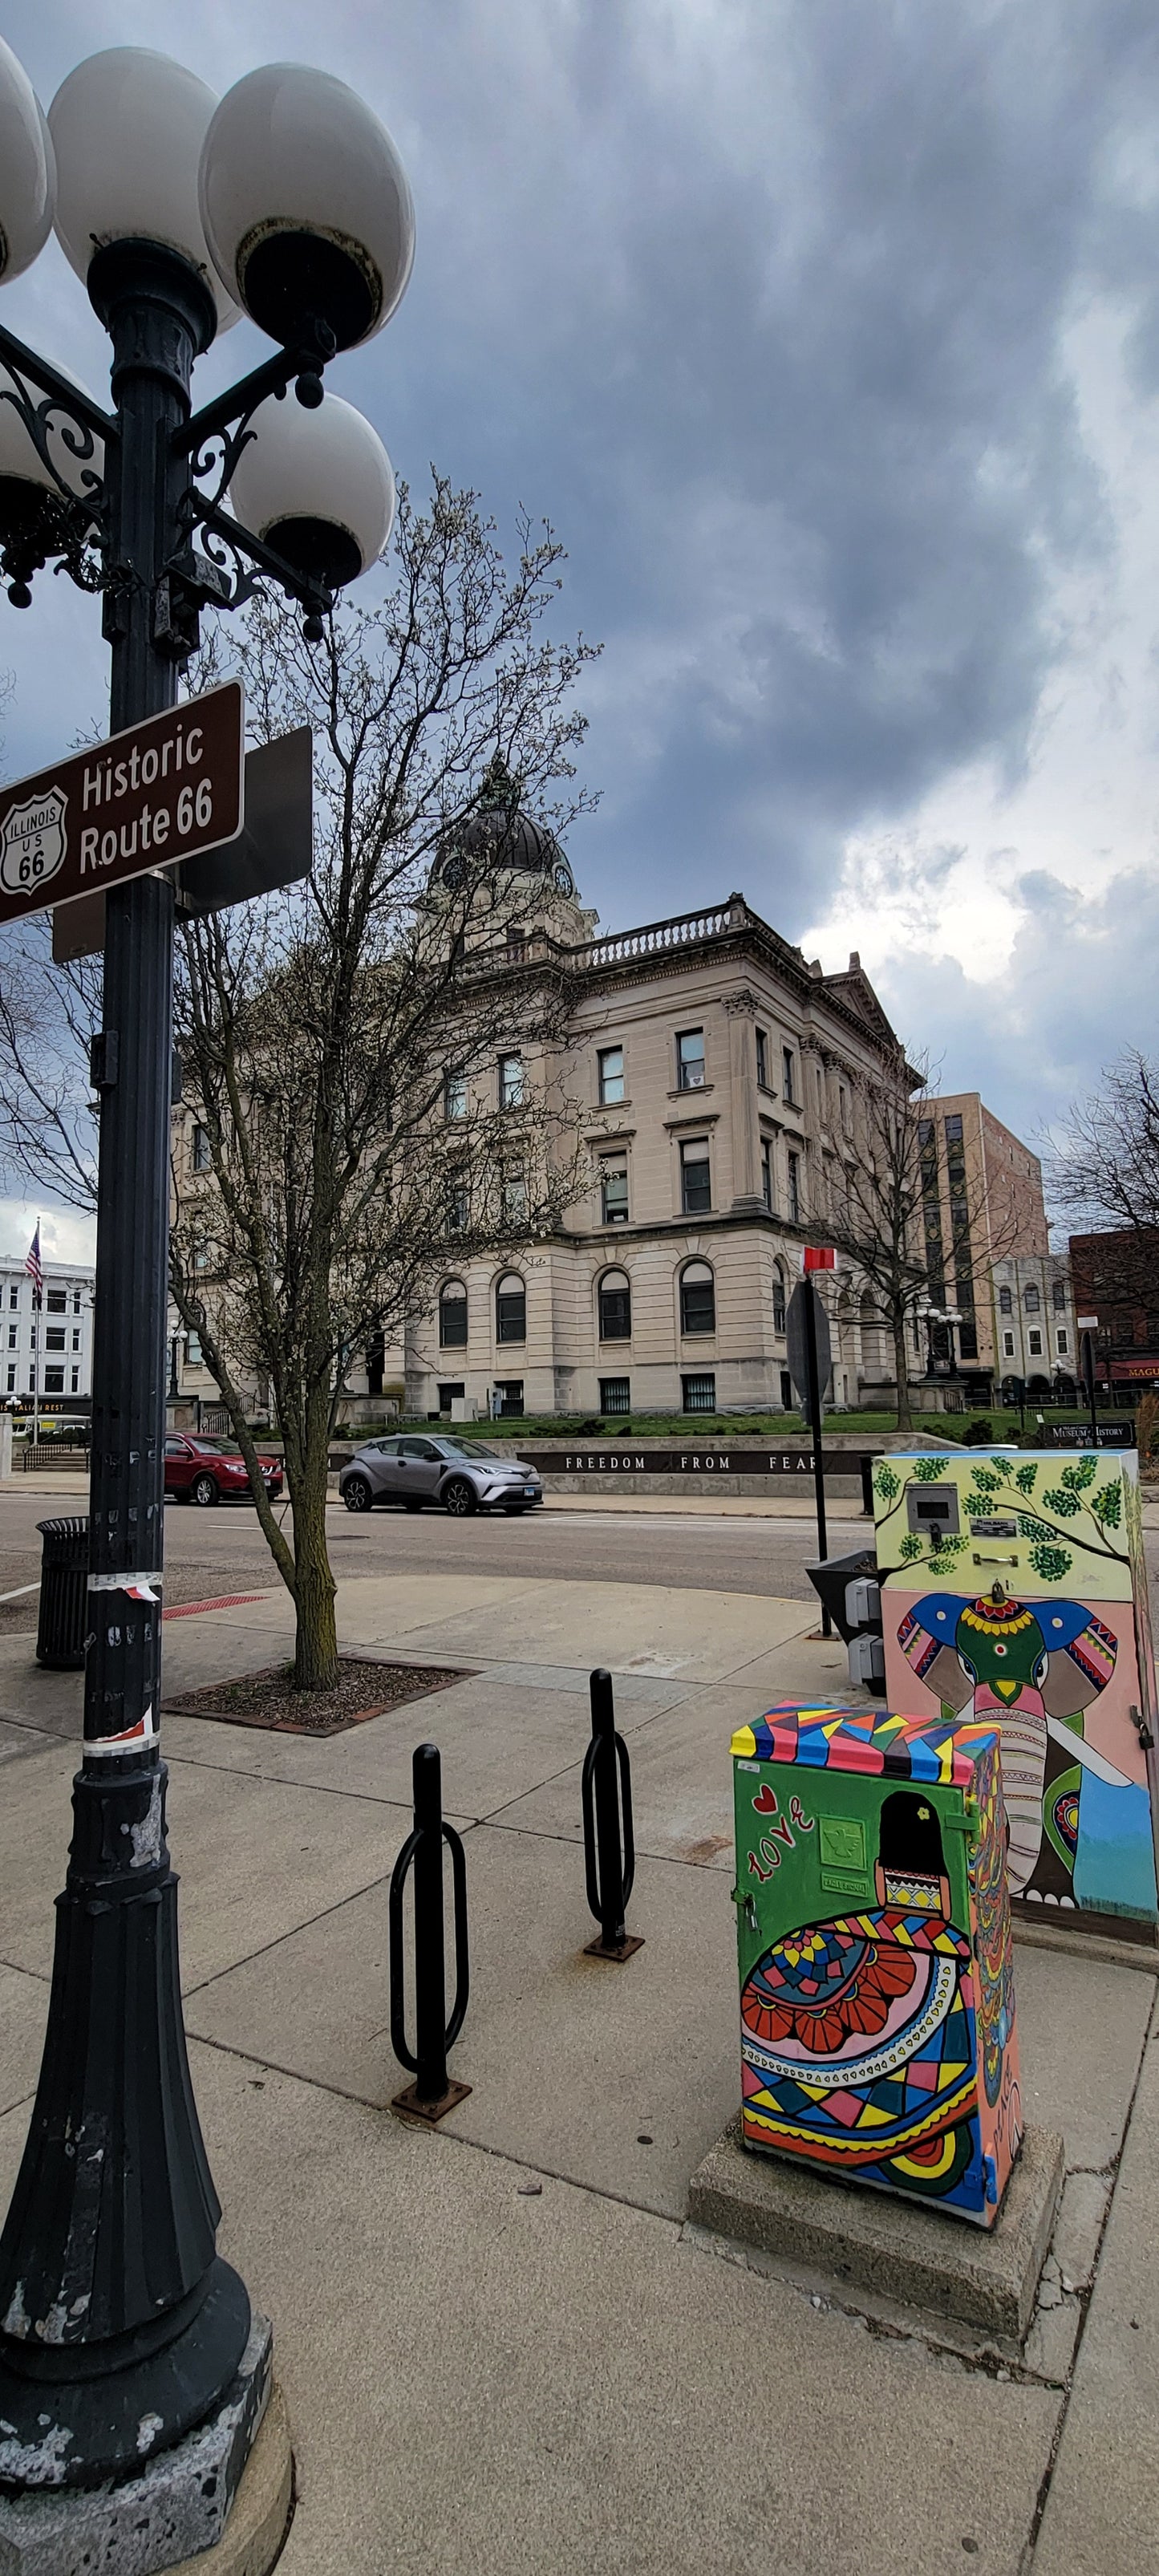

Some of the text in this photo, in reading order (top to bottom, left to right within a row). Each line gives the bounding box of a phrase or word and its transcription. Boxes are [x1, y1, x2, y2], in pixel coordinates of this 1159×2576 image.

[82, 724, 204, 811] Historic
[10, 806, 56, 839] ILLINOIS
[79, 777, 213, 874] Route 66
[18, 850, 45, 882] 66
[1129, 1368, 1159, 1377] MAGU
[565, 1456, 817, 1470] FREEDOM FROM FEAR
